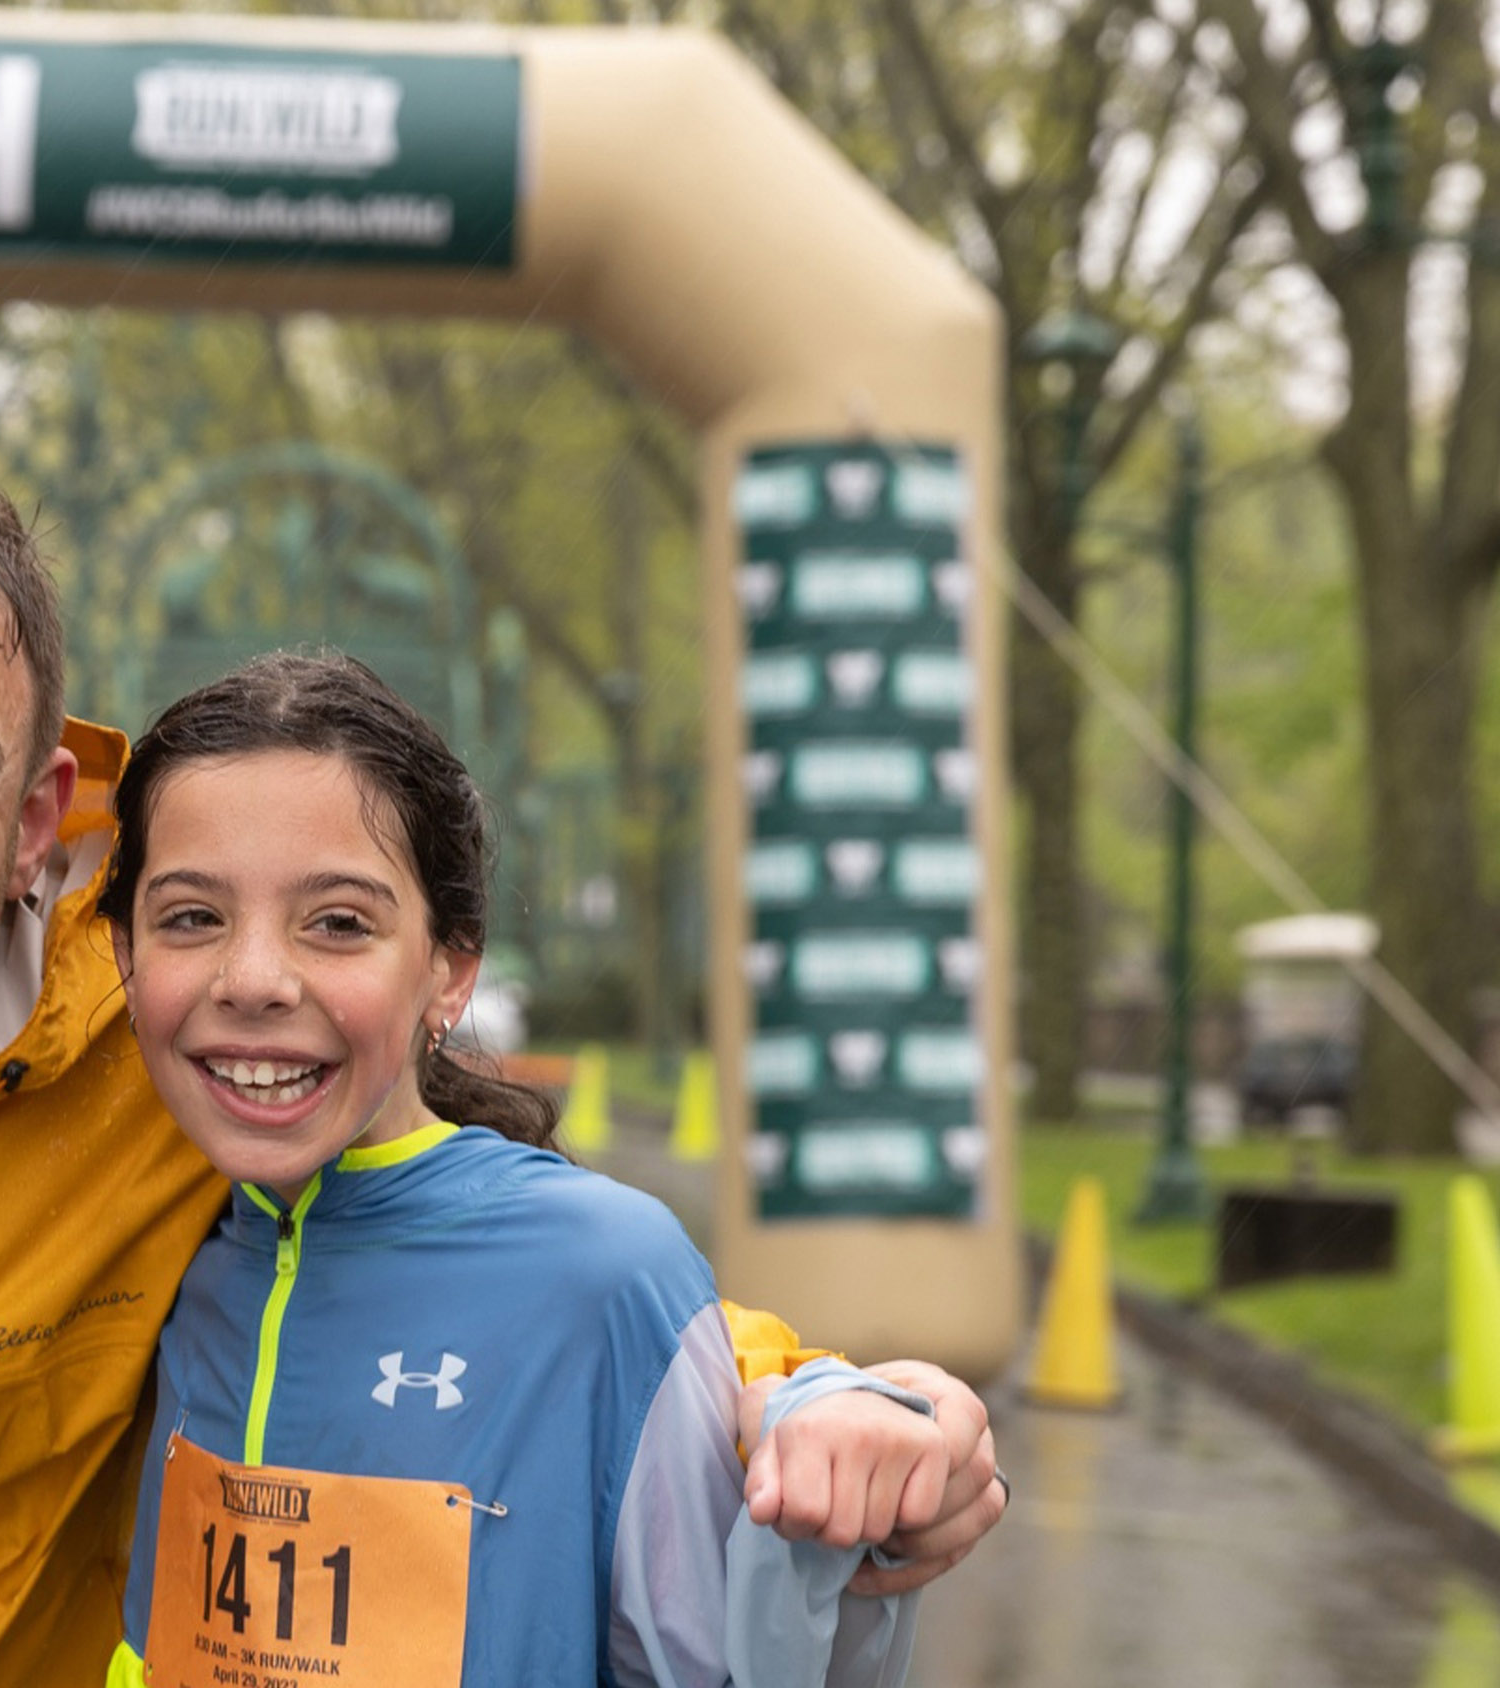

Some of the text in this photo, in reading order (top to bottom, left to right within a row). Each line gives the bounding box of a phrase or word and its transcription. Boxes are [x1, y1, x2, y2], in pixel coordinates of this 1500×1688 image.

[255, 1484, 303, 1519] WILD
[203, 1523, 350, 1646] 1411
[211, 1640, 227, 1659] AM
[259, 1651, 340, 1676] RUN/WALK
[213, 1665, 238, 1685] April
